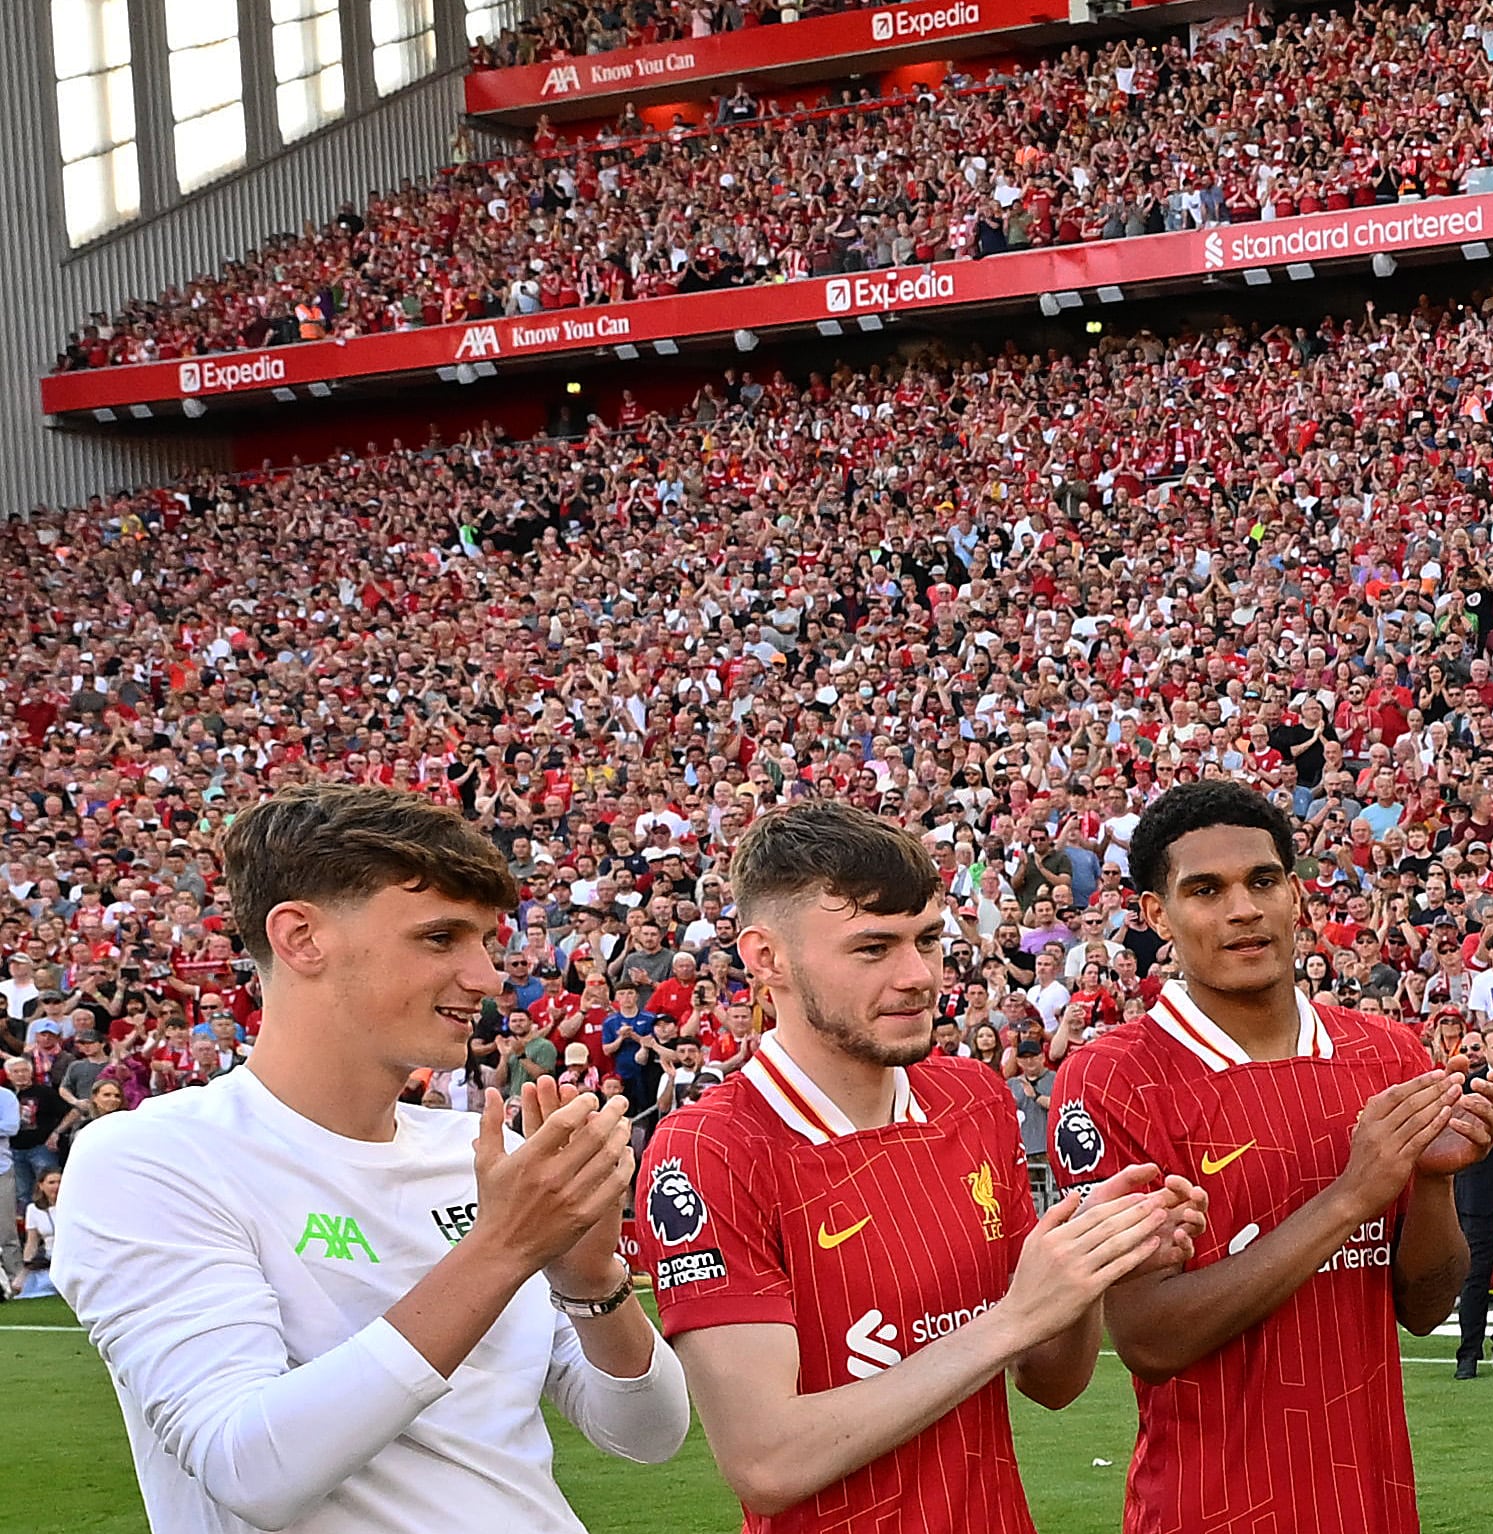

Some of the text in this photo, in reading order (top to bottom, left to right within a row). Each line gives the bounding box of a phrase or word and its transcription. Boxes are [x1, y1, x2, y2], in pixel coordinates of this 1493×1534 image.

[896, 1, 979, 36] Expedia
[540, 53, 695, 95] AXA Know You Can
[1231, 206, 1483, 261] standard chartered
[855, 271, 954, 309] Expedia
[455, 316, 629, 358] AXA Know You Can
[203, 355, 285, 389] Expedia
[294, 1213, 380, 1263] AXA
[619, 1236, 640, 1255] Yo
[671, 1252, 715, 1272] room
[673, 1264, 726, 1286] racism
[912, 1299, 1001, 1343] stand
